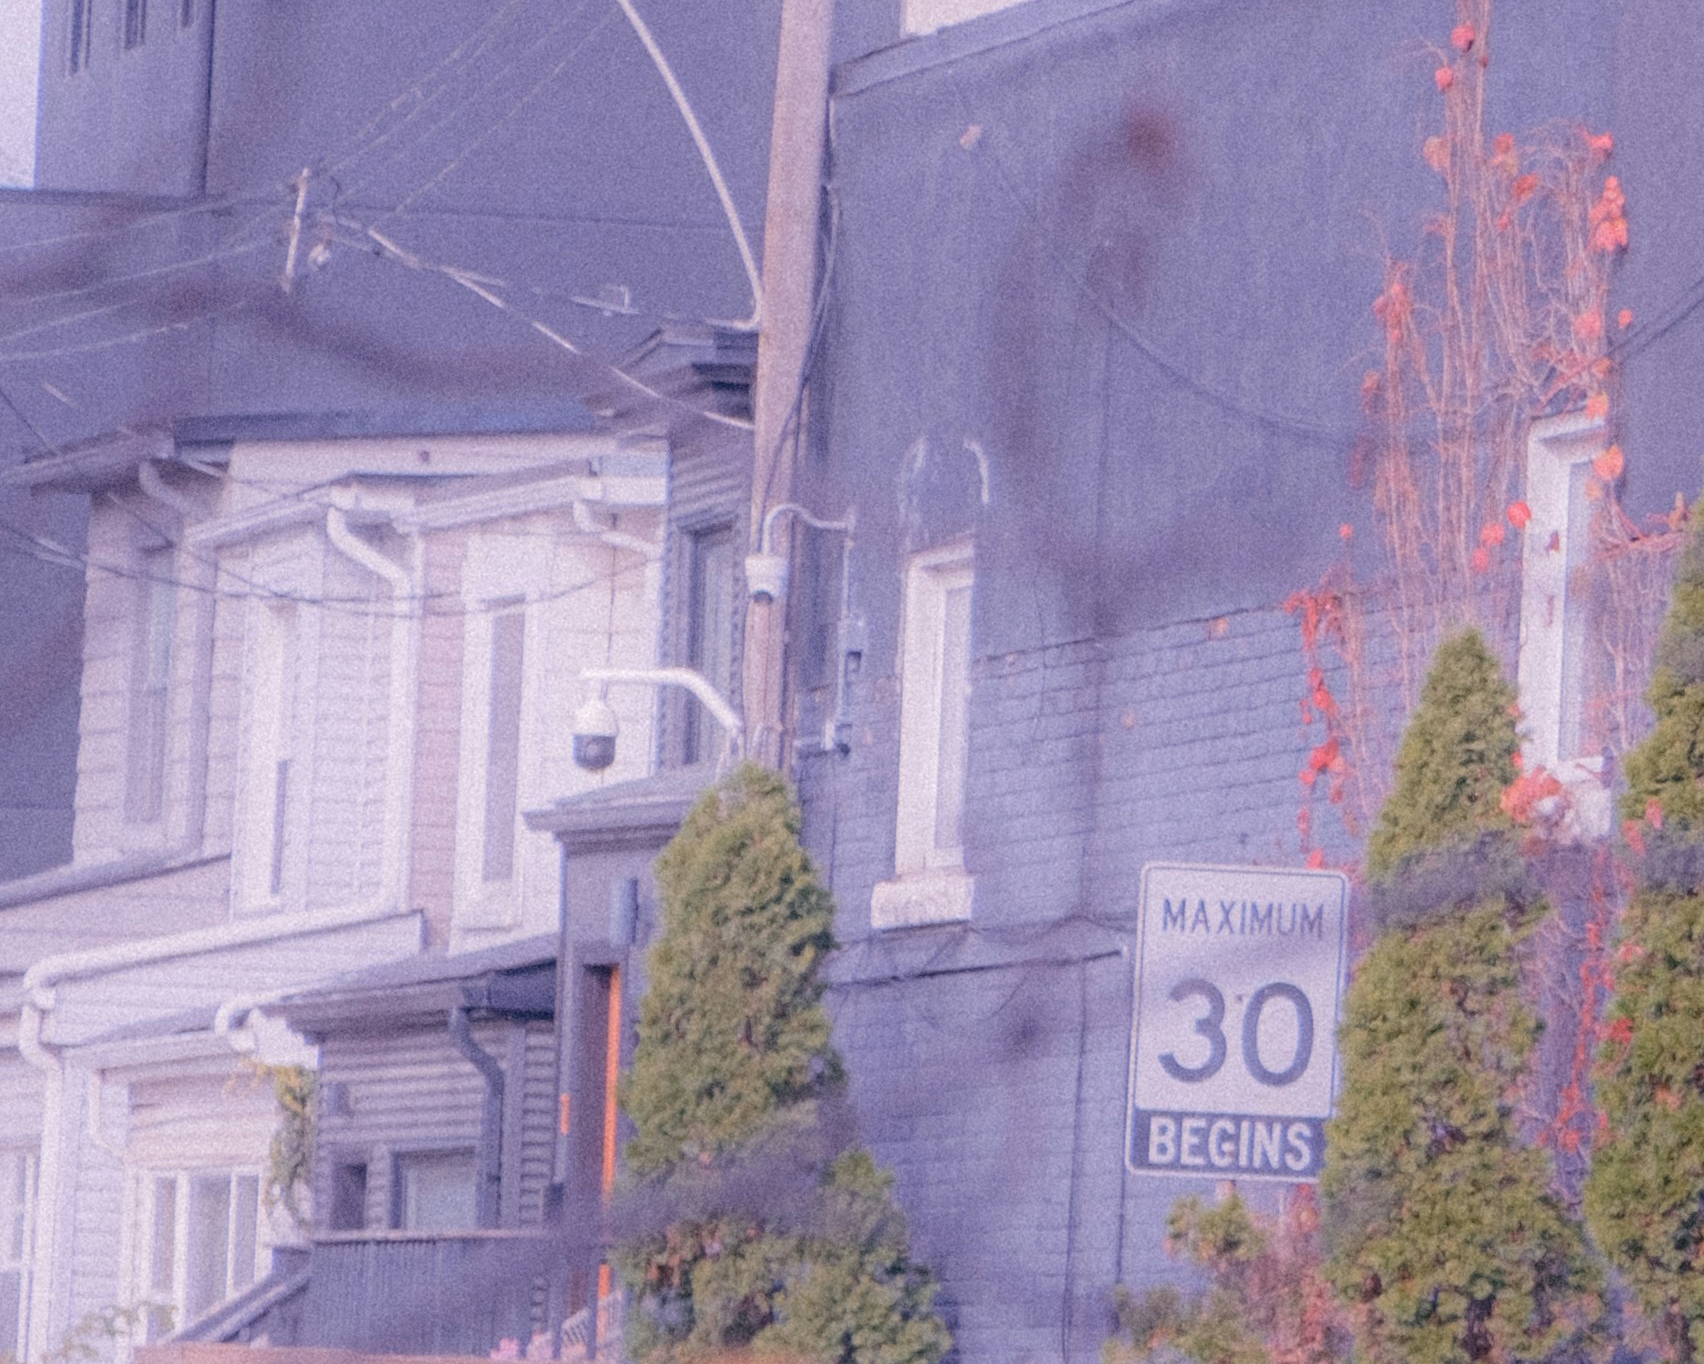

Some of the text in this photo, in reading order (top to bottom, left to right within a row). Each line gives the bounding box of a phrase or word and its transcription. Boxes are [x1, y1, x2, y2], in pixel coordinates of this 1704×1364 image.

[1162, 898, 1325, 937] MAXIMUM
[1158, 978, 1314, 1088] 30
[1148, 1115, 1312, 1172] BEGINS
